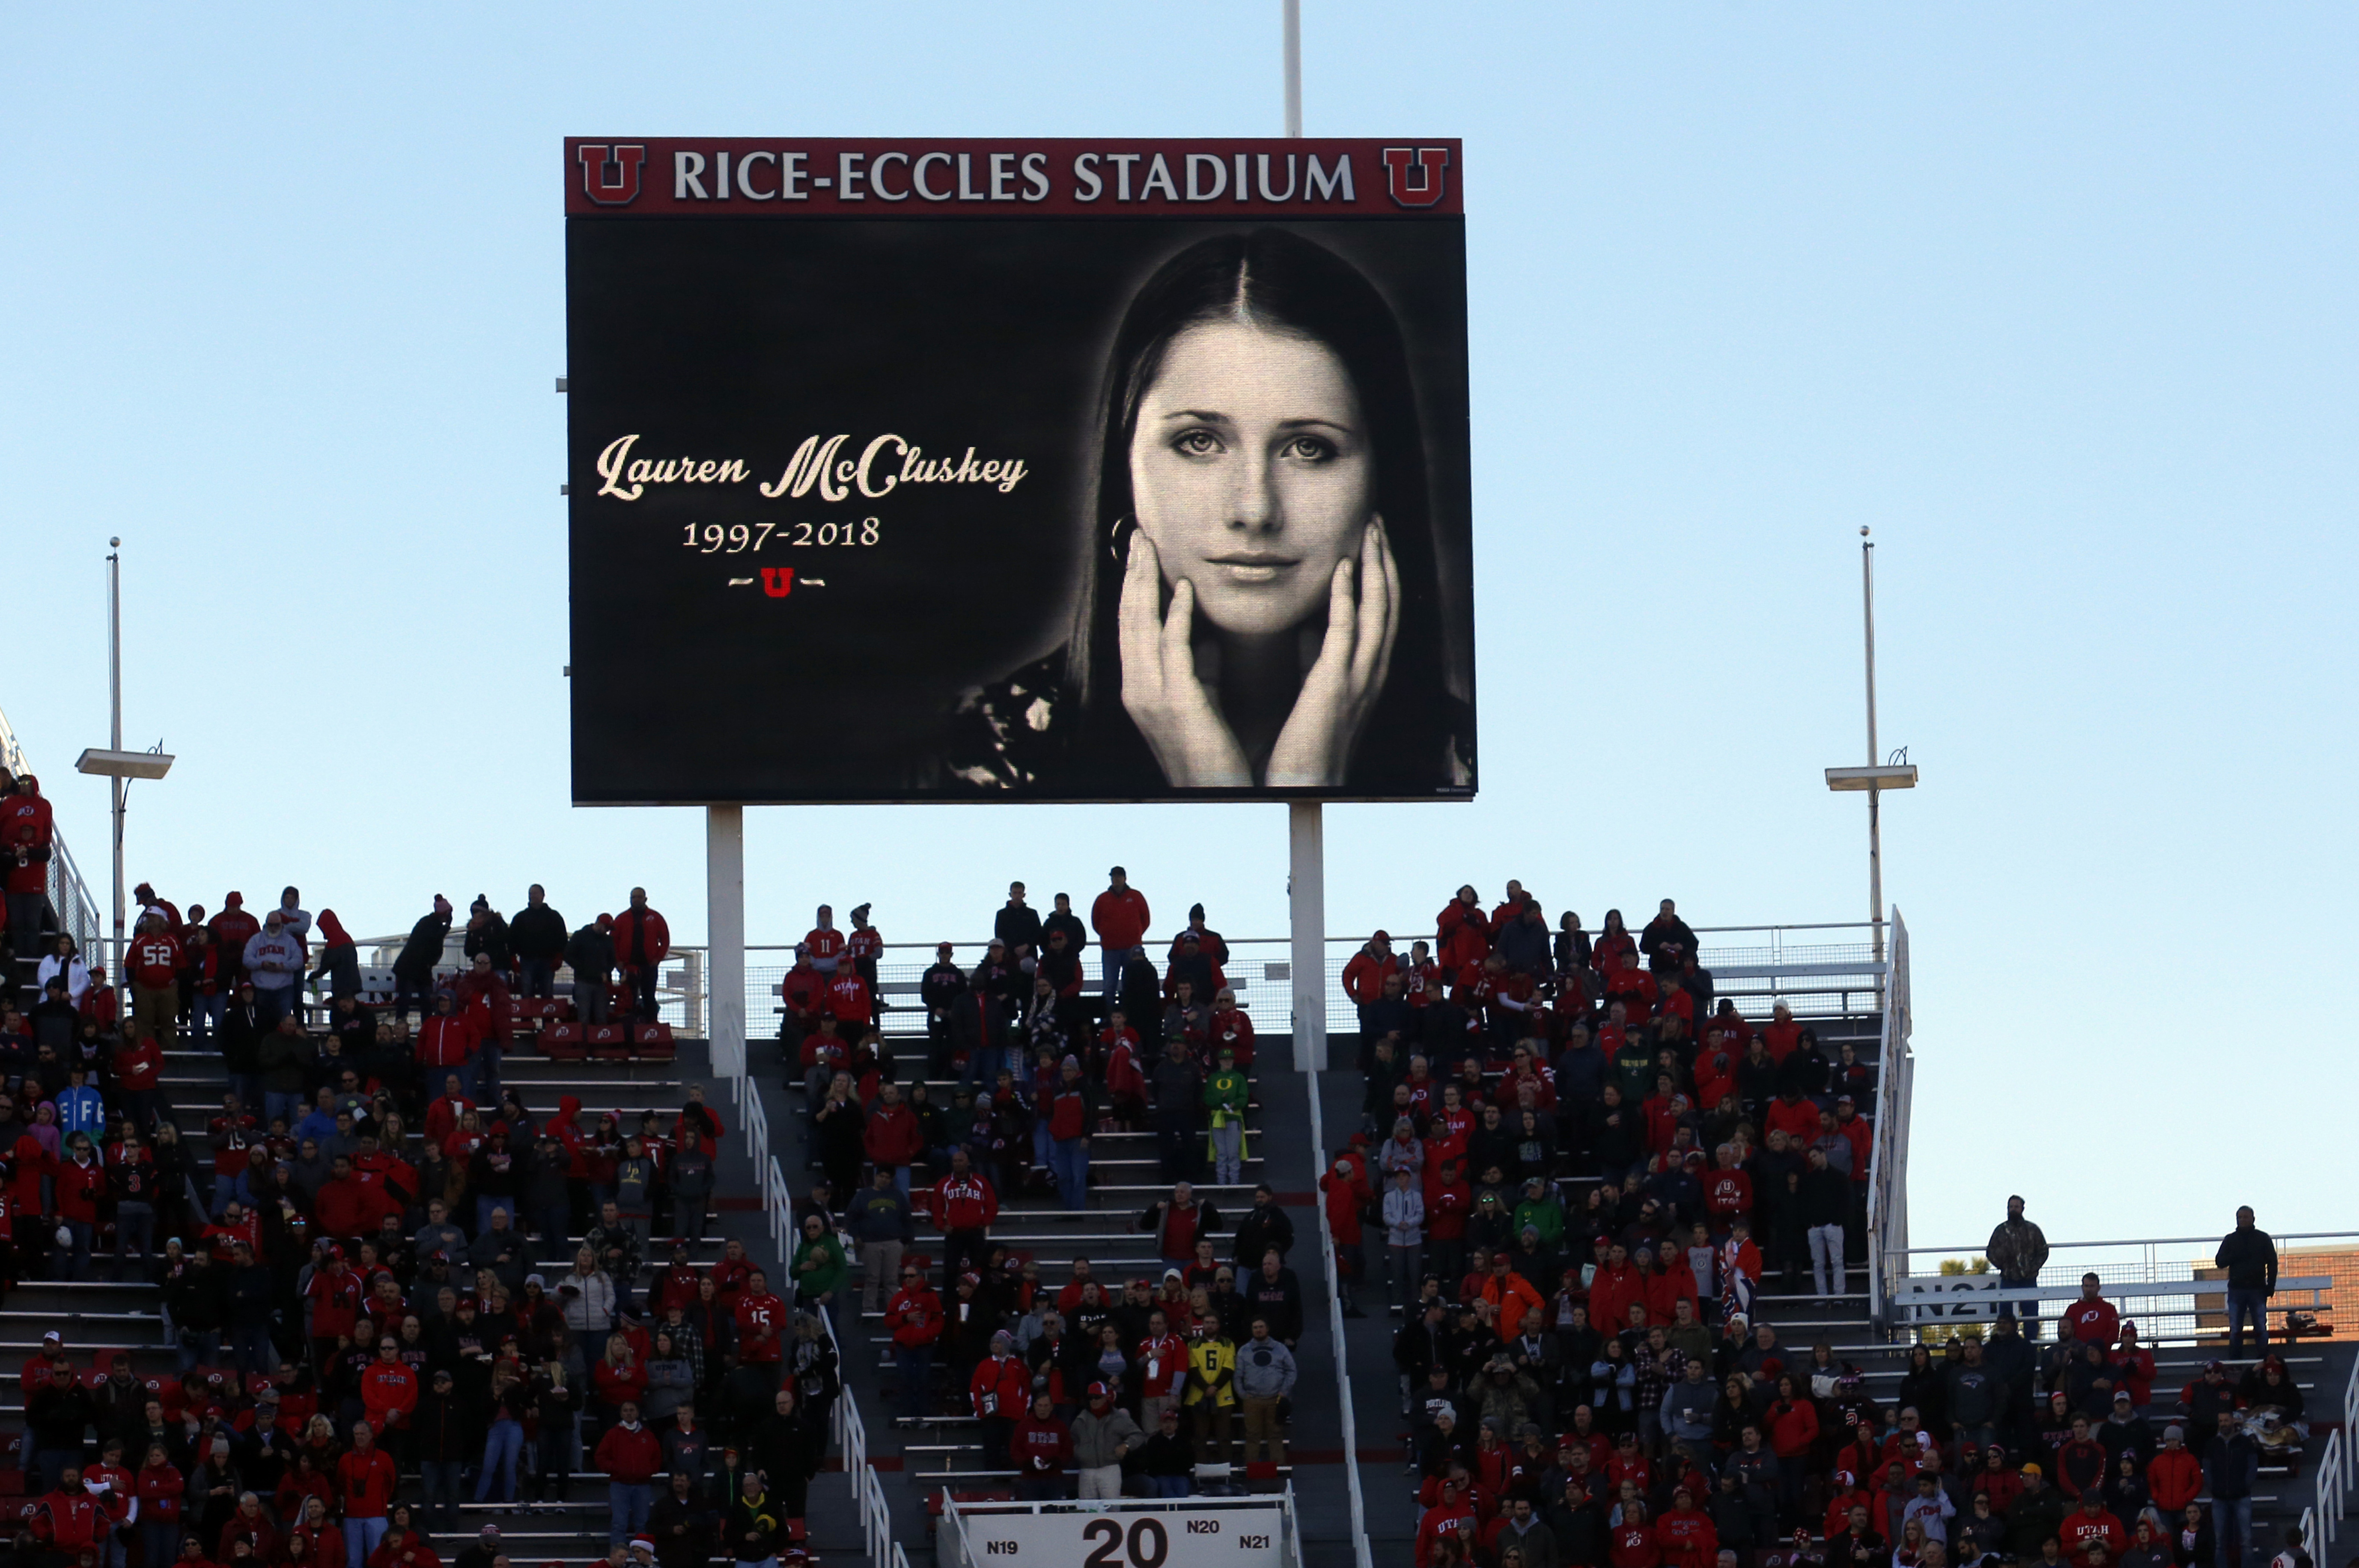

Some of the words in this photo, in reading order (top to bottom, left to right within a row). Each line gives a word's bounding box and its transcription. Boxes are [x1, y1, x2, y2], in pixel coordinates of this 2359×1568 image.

[578, 145, 645, 204] U
[675, 152, 1049, 200] RICE-ECCLES
[1075, 153, 1354, 201] STADIUM
[1383, 148, 1448, 206] U
[597, 434, 750, 501] Lauren
[760, 434, 1028, 501] McCluskey
[683, 518, 879, 553] 1997-2018
[259, 944, 285, 956] UTAH
[820, 939, 830, 953] 11
[143, 945, 171, 966] 52
[834, 982, 860, 992] UTAH
[482, 993, 490, 1009] 4
[1724, 1029, 1736, 1039] AH
[1216, 1078, 1232, 1090] O
[81, 1100, 92, 1122] F
[1448, 1121, 1465, 1129] TAH
[228, 1132, 246, 1150] 15
[650, 1148, 658, 1168] 1
[128, 1174, 141, 1192] 3
[947, 1187, 980, 1201] UTAH
[1912, 1281, 1997, 1317] N21
[751, 1311, 770, 1327] 15
[1206, 1350, 1217, 1371] 6
[377, 1375, 406, 1386] UTAH
[1028, 1431, 1058, 1443] UTAH
[2042, 1430, 2074, 1440] UTAH
[1187, 1520, 1220, 1534] N20
[2077, 1525, 2109, 1536] UTAH
[987, 1541, 1019, 1555] N19
[1083, 1517, 1168, 1568] 20
[1239, 1535, 1270, 1549] N21
